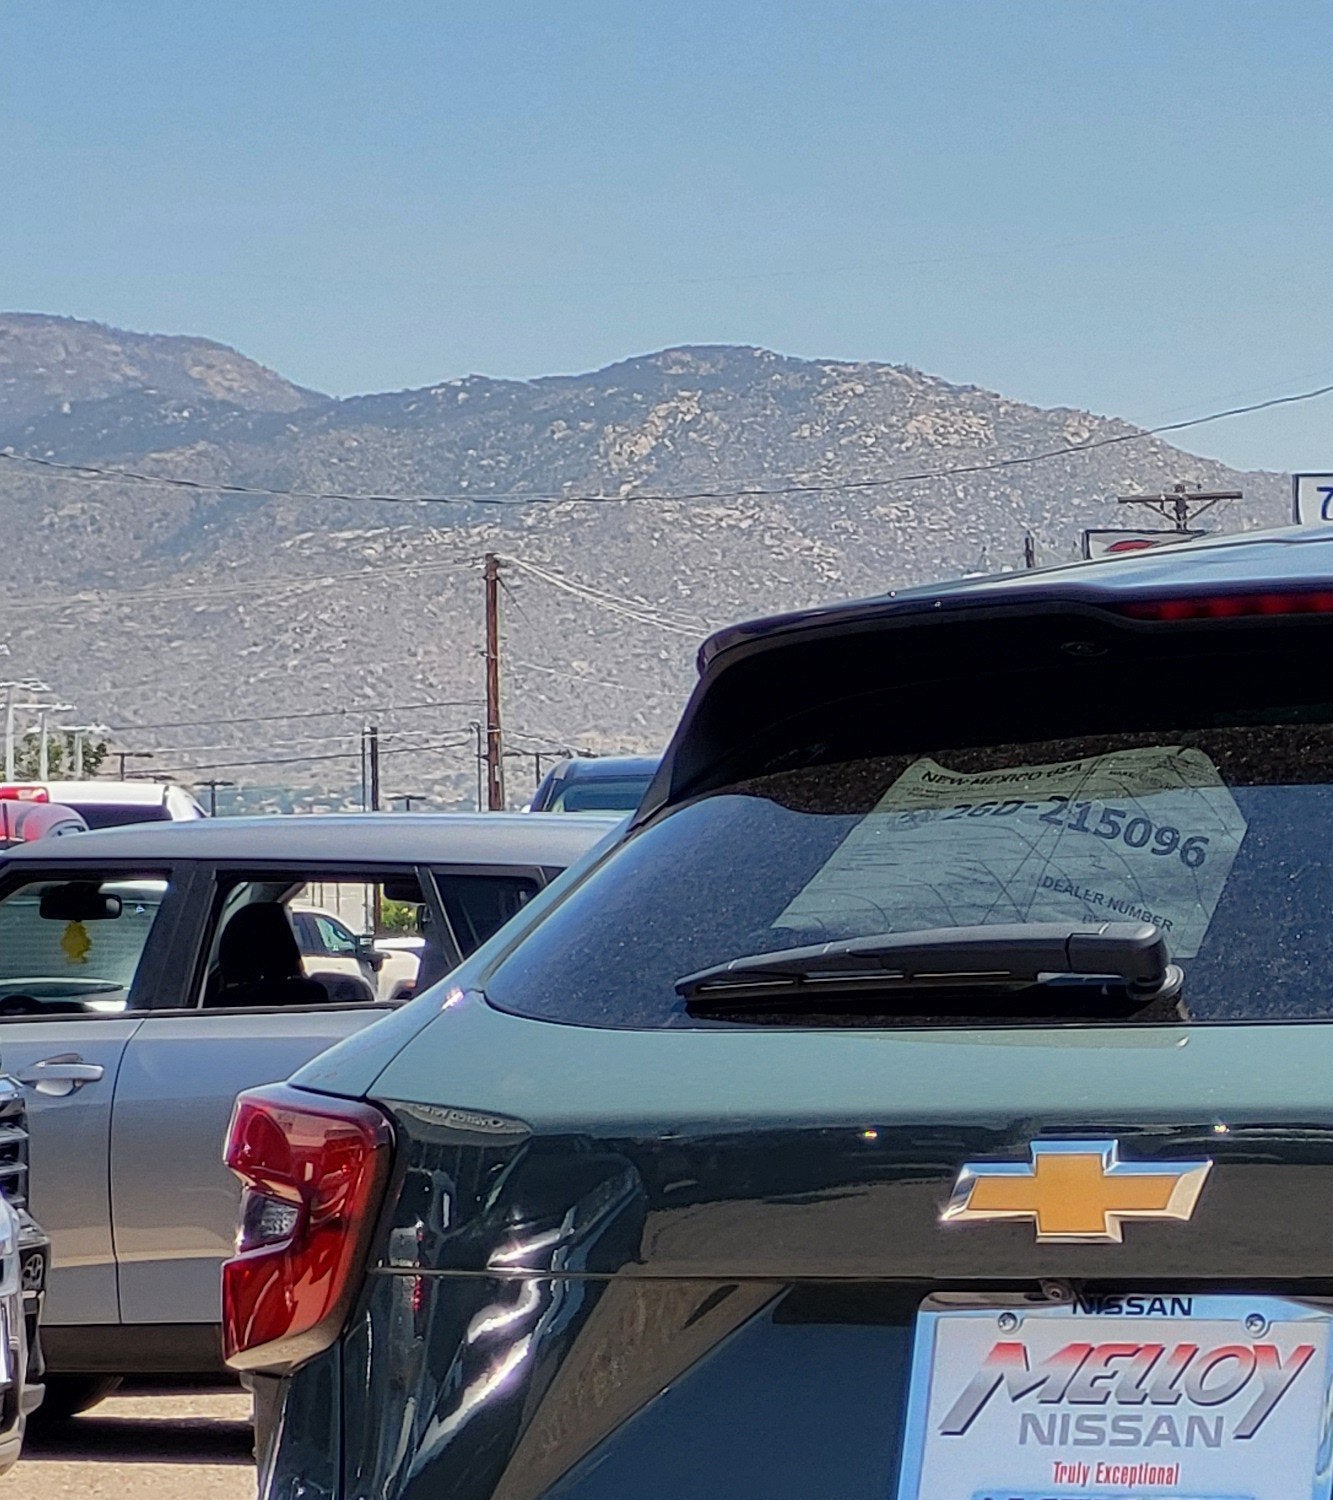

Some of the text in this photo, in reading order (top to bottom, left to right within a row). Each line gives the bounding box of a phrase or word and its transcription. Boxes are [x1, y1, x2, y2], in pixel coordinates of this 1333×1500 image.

[921, 770, 968, 786] NEW
[970, 771, 1042, 786] MEXICO
[1042, 875, 1174, 933] DEALER NUMBER
[1072, 1296, 1192, 1316] NISSAN
[938, 1341, 1315, 1439] MELLOY
[1018, 1413, 1224, 1448] NISSAN
[1053, 1461, 1180, 1488] Truly Exceptional
